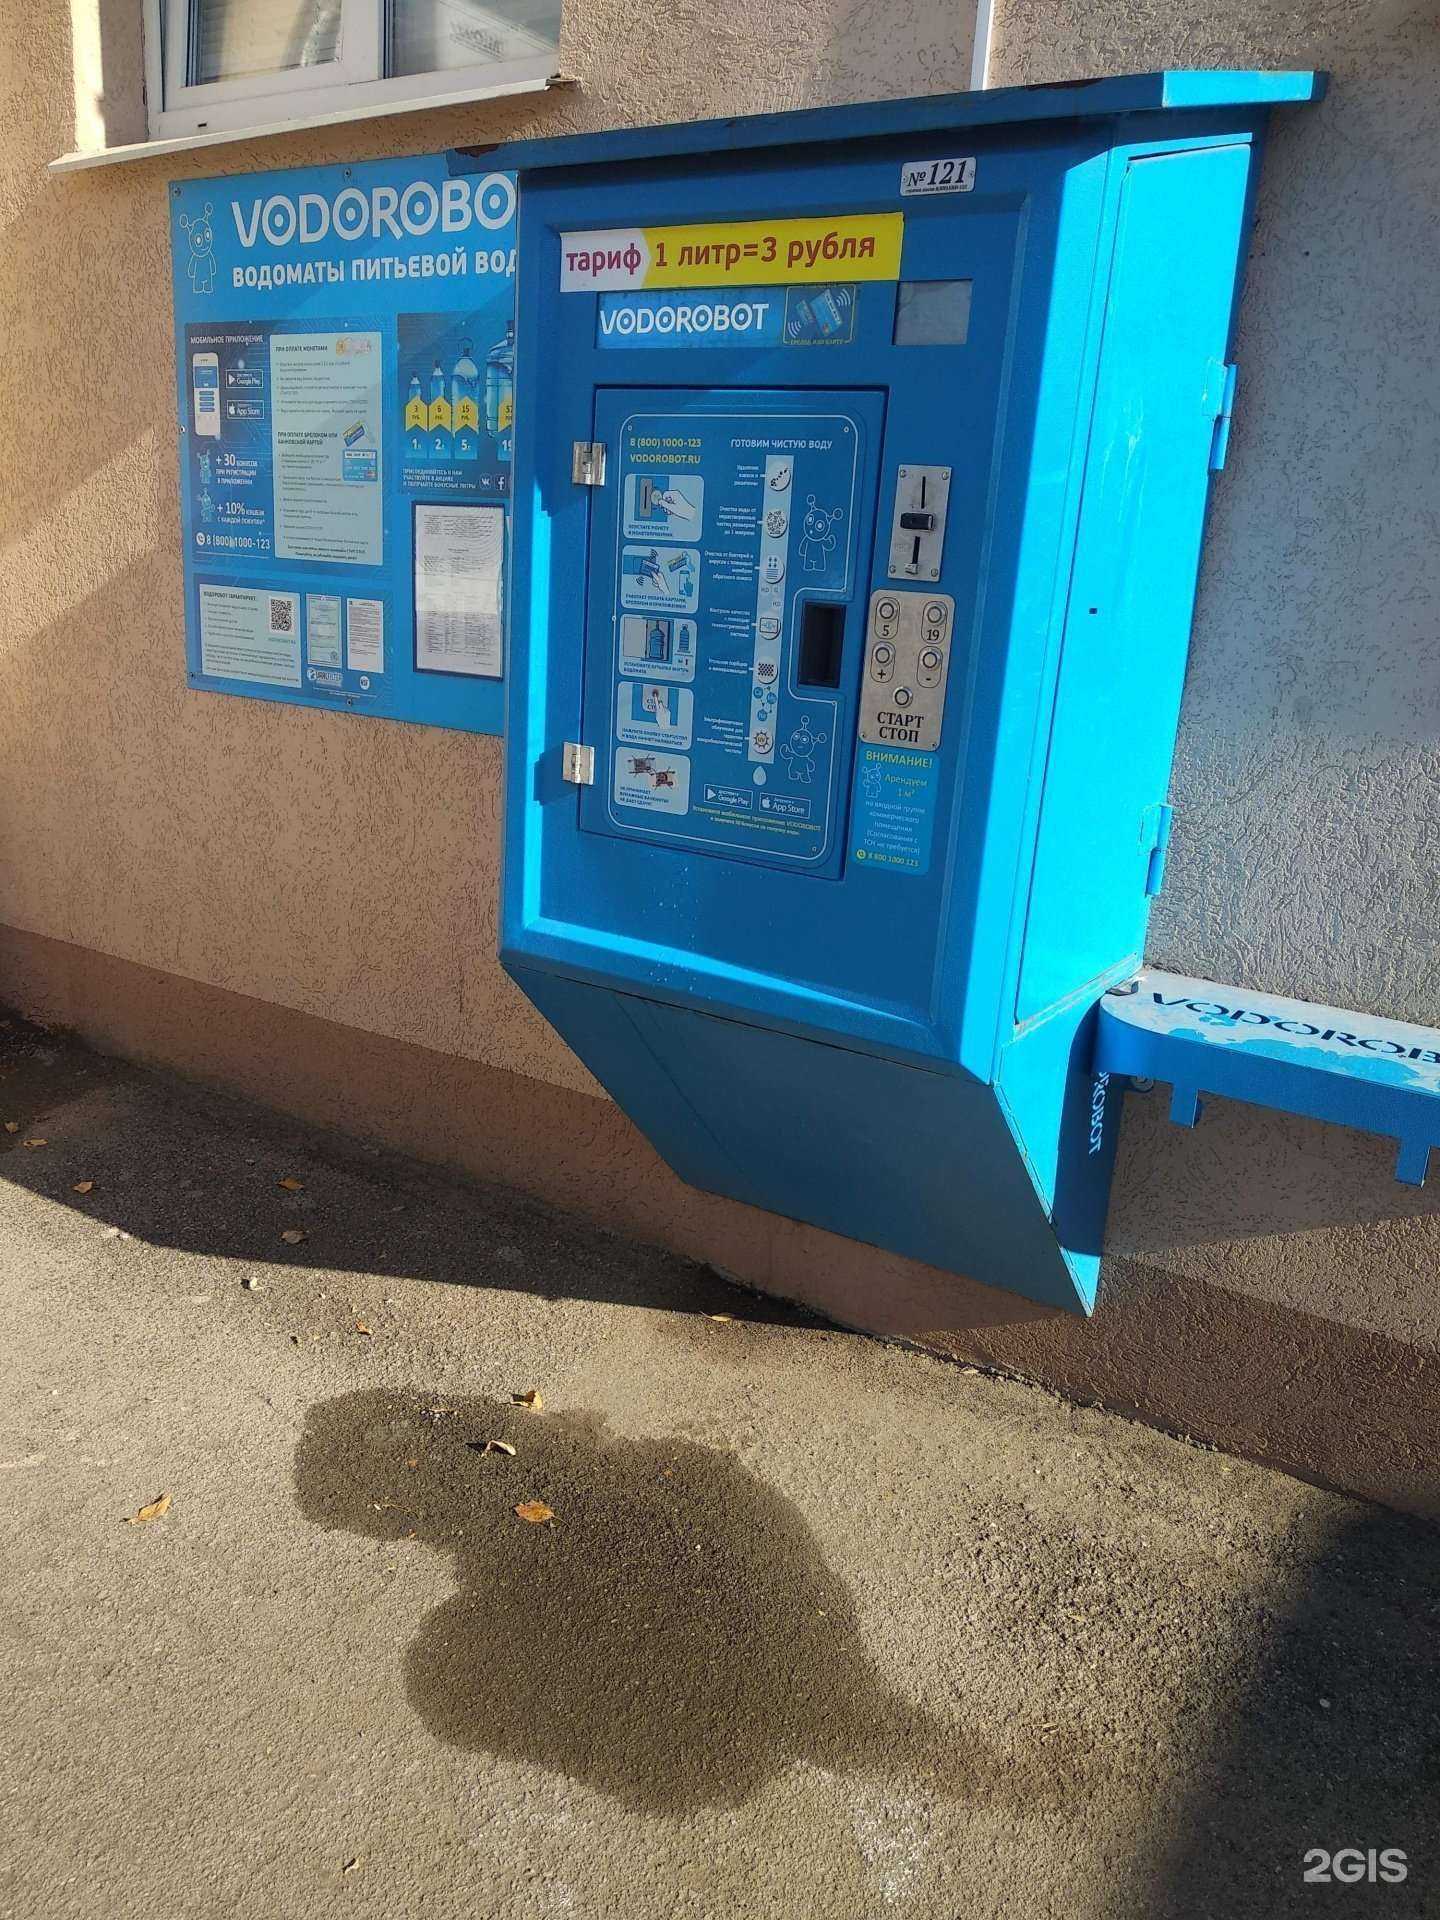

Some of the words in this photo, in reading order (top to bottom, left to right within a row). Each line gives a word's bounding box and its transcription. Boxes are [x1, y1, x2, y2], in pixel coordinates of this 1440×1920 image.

[566, 243, 642, 277] тариф
[655, 243, 668, 267] 1
[787, 231, 876, 269] рубля
[232, 260, 345, 290] ВОДОМАТЫ
[351, 246, 467, 281] ПИТЬЕВОЙ
[600, 303, 769, 335] VODOROBOT
[190, 336, 224, 344] МОБИЛЬНОЕ
[225, 335, 263, 344] ПРИЛОЖЕНИЕ
[637, 438, 660, 448] (800)
[730, 439, 769, 448] ГОТОВИМ
[771, 439, 806, 449] ЧИСТУЮ
[808, 440, 832, 450] ВОДУ
[224, 453, 236, 466] 30
[630, 454, 701, 464] VODOROBOT.RU
[226, 502, 245, 515] 10%
[234, 537, 270, 550] 1000-123
[882, 624, 890, 636] 5
[926, 629, 940, 641] 19
[876, 711, 924, 729] СТАРТ
[879, 726, 919, 742] СТОП
[866, 751, 933, 768] ВНИМАНИЕ!
[884, 774, 928, 787] Арендуем
[718, 795, 737, 804] Google
[772, 803, 787, 813] App
